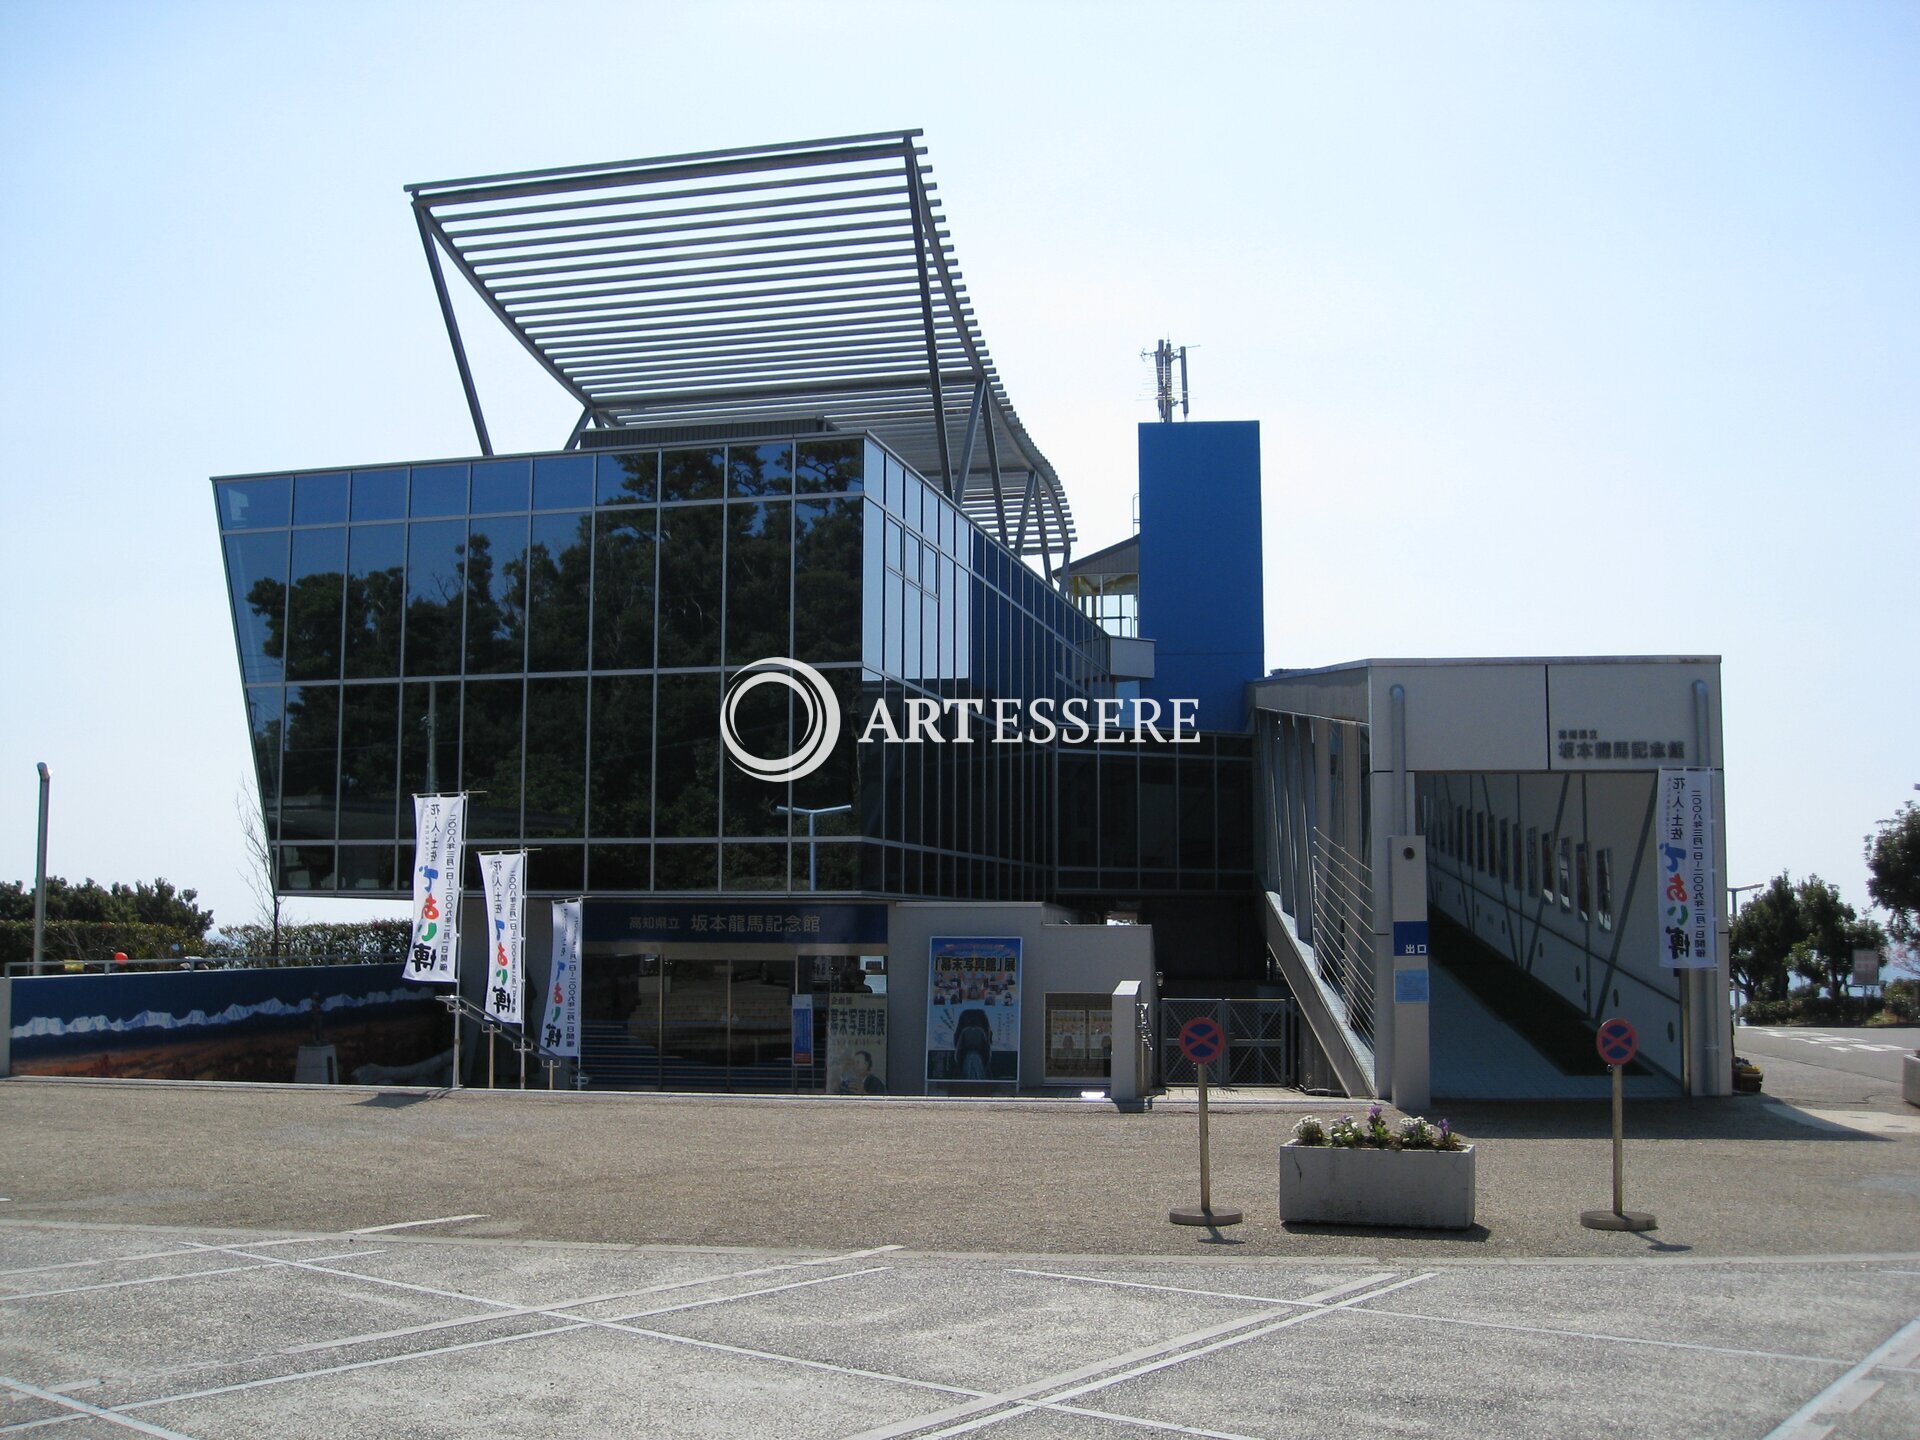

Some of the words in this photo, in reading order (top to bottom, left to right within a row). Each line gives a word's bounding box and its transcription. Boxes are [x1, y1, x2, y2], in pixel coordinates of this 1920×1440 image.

[629, 916, 681, 930] 高知県立
[691, 914, 822, 933] 坂本龍馬記念館
[1405, 943, 1427, 954] 出口
